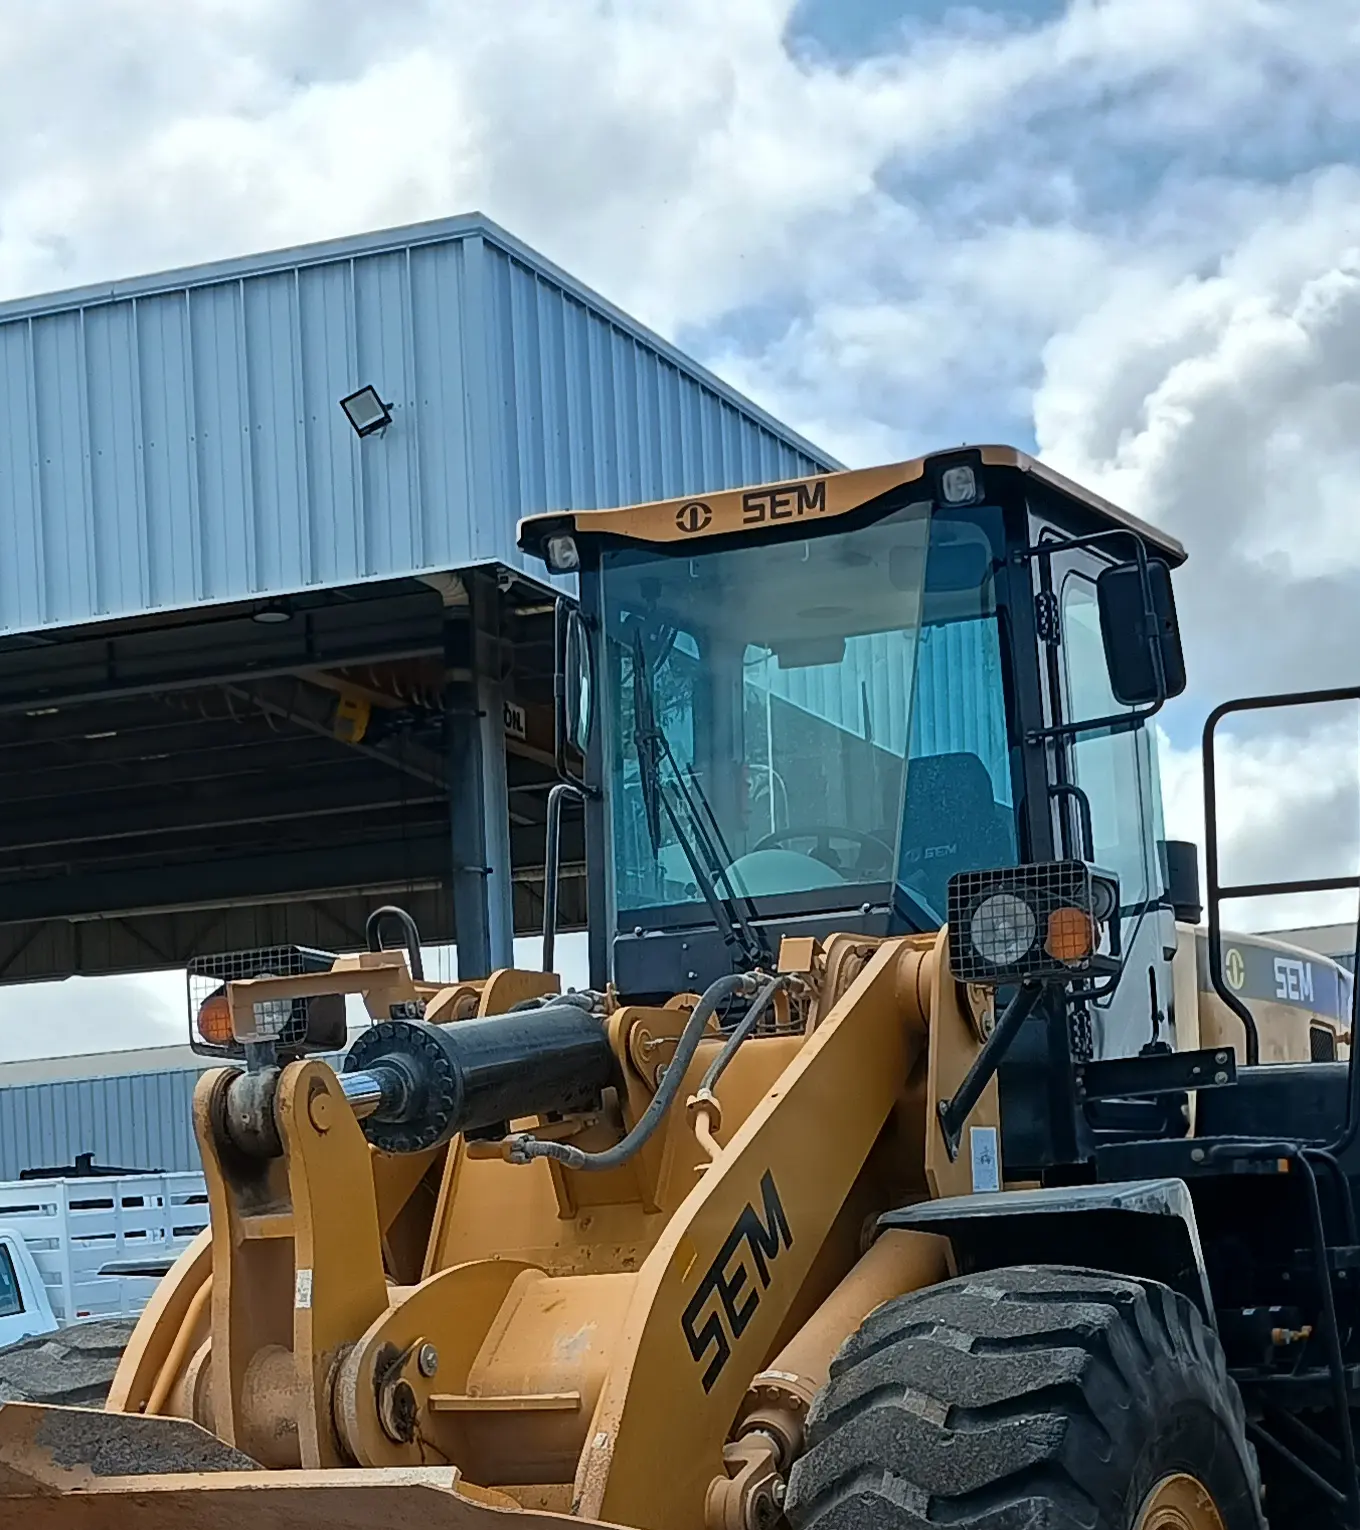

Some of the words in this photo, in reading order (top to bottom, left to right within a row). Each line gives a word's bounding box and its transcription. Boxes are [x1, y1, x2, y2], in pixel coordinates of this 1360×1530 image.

[742, 480, 827, 525] SEM
[924, 843, 958, 859] SEM
[1273, 957, 1315, 1002] SEM
[681, 1167, 794, 1396] SEM
